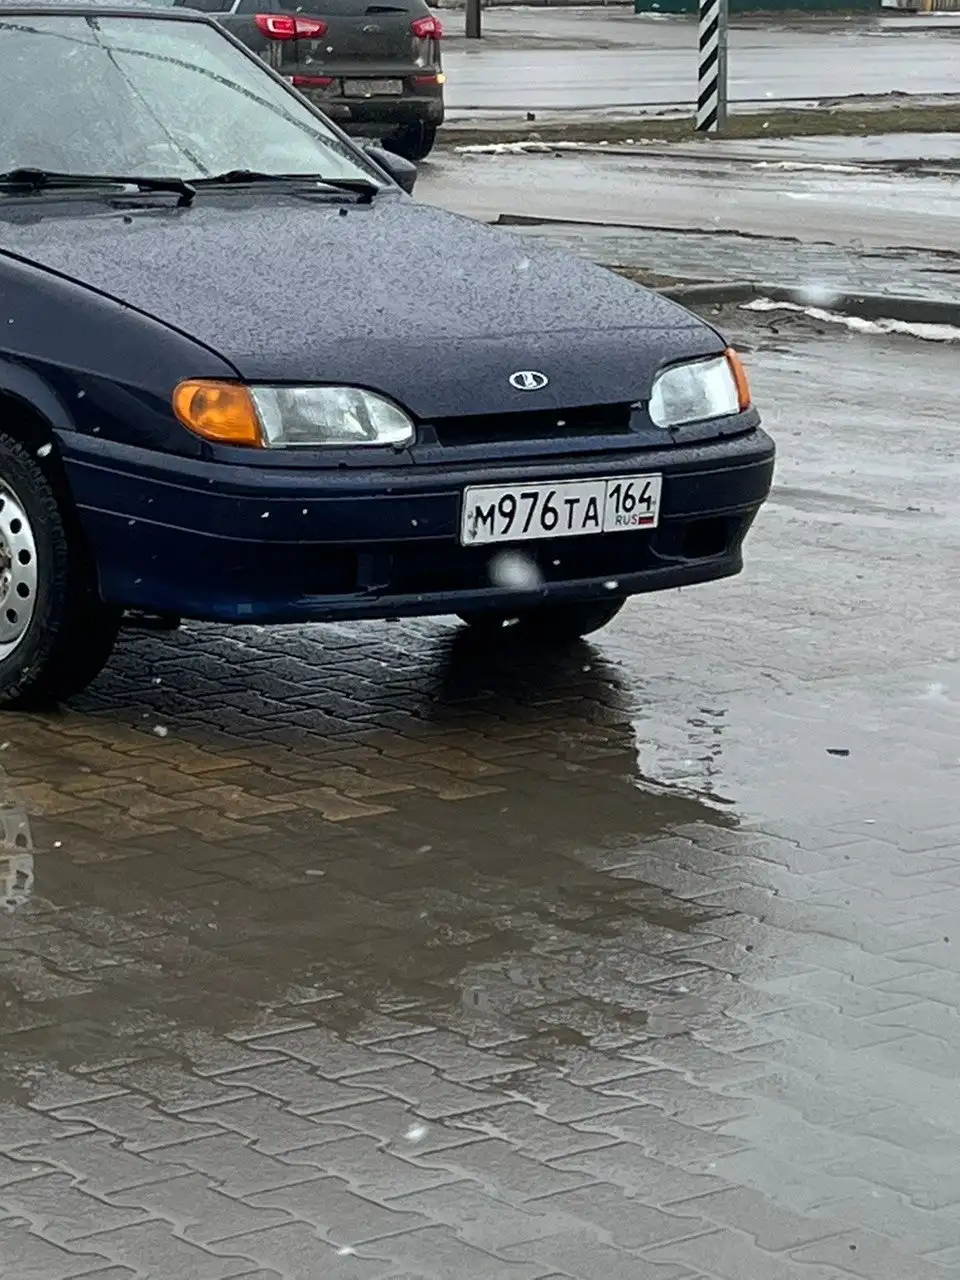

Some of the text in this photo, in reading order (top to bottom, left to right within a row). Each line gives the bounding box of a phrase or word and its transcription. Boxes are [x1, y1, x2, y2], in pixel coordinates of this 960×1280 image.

[474, 481, 652, 535] М976ТА 164
[615, 513, 638, 525] RUS
